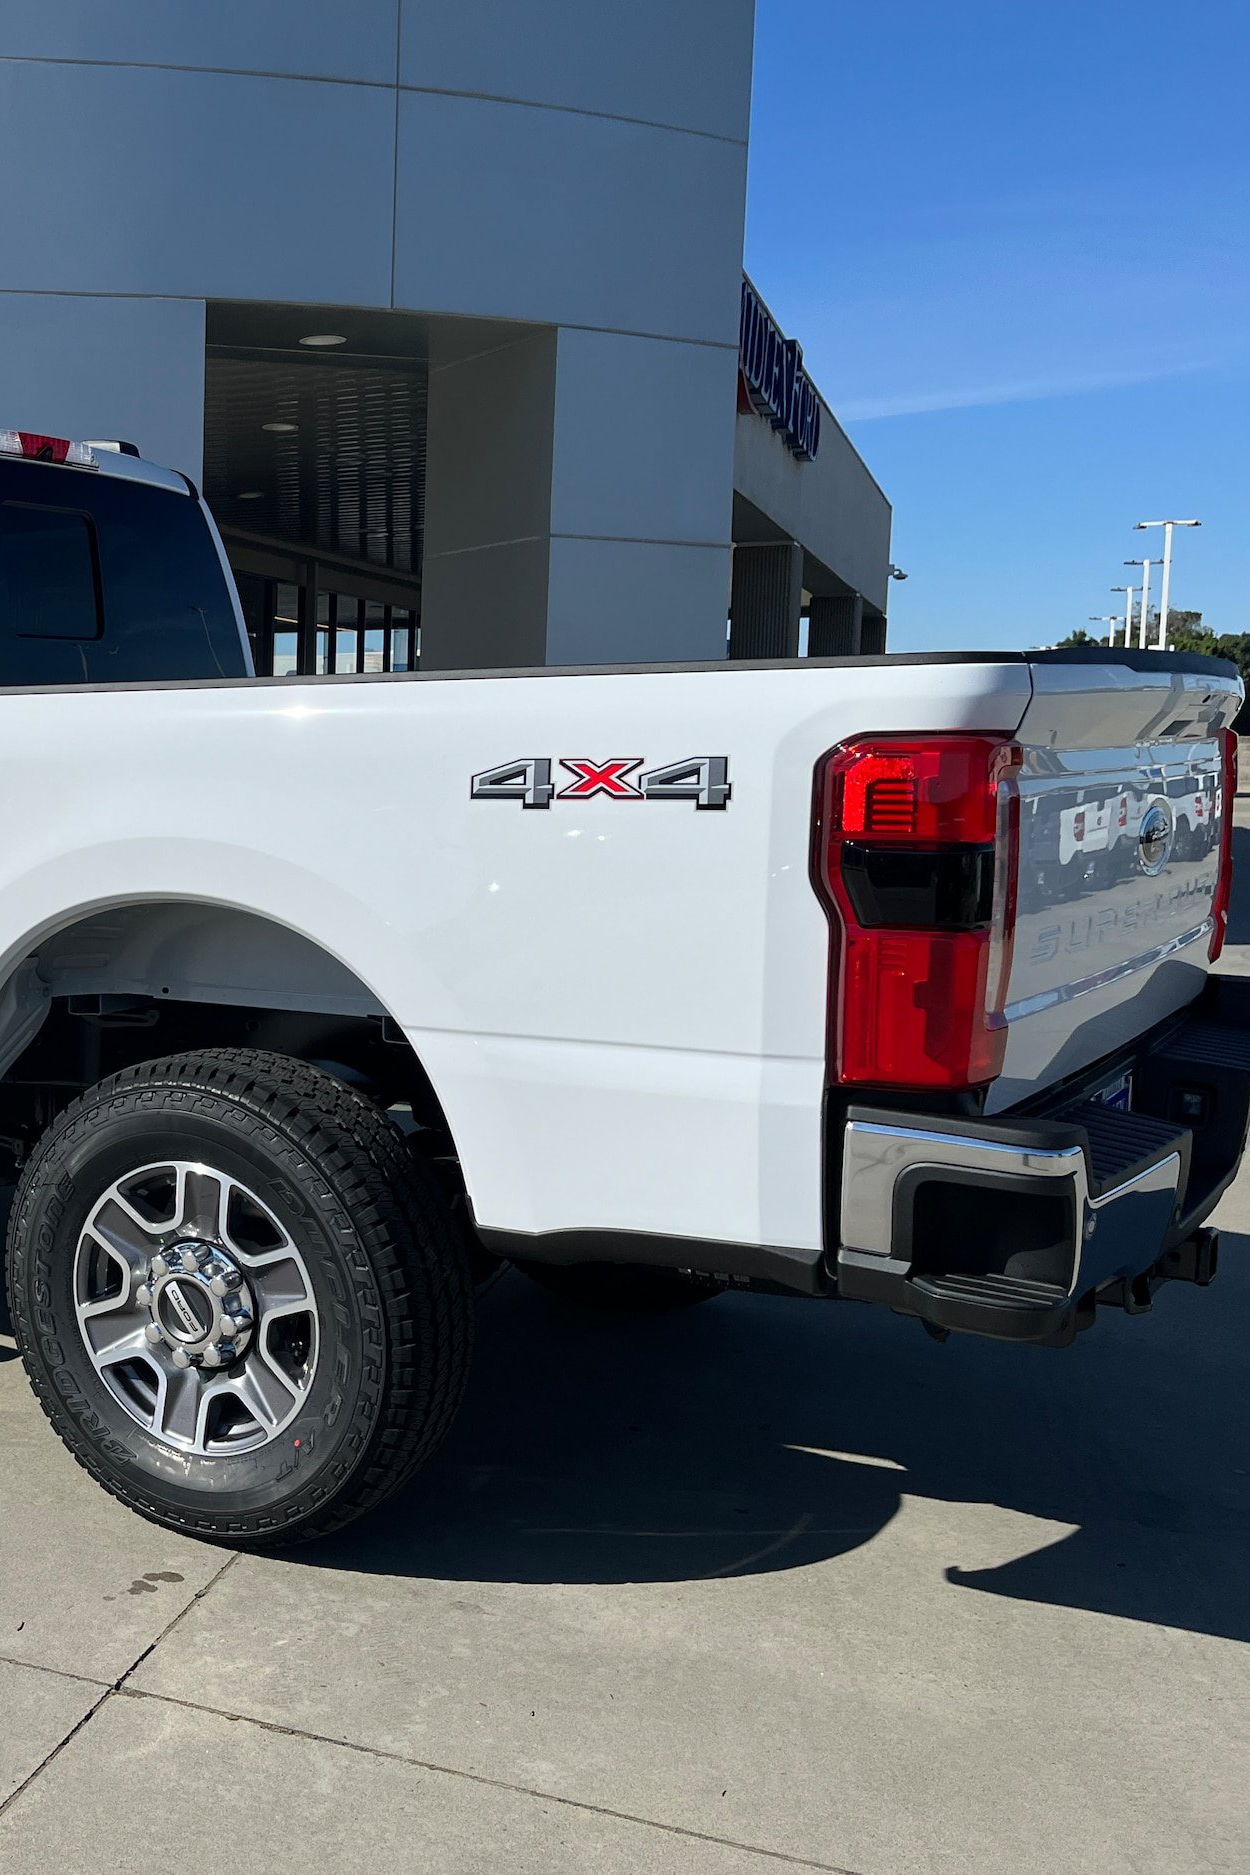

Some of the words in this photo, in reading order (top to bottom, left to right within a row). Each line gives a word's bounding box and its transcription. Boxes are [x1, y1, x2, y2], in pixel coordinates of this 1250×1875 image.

[787, 345, 821, 462] FORD
[470, 756, 732, 811] 4X4
[1030, 894, 1163, 968] SUPER
[32, 1175, 139, 1466] BRIDGESTONE
[171, 1289, 199, 1332] FORD
[266, 1177, 352, 1427] DUELER
